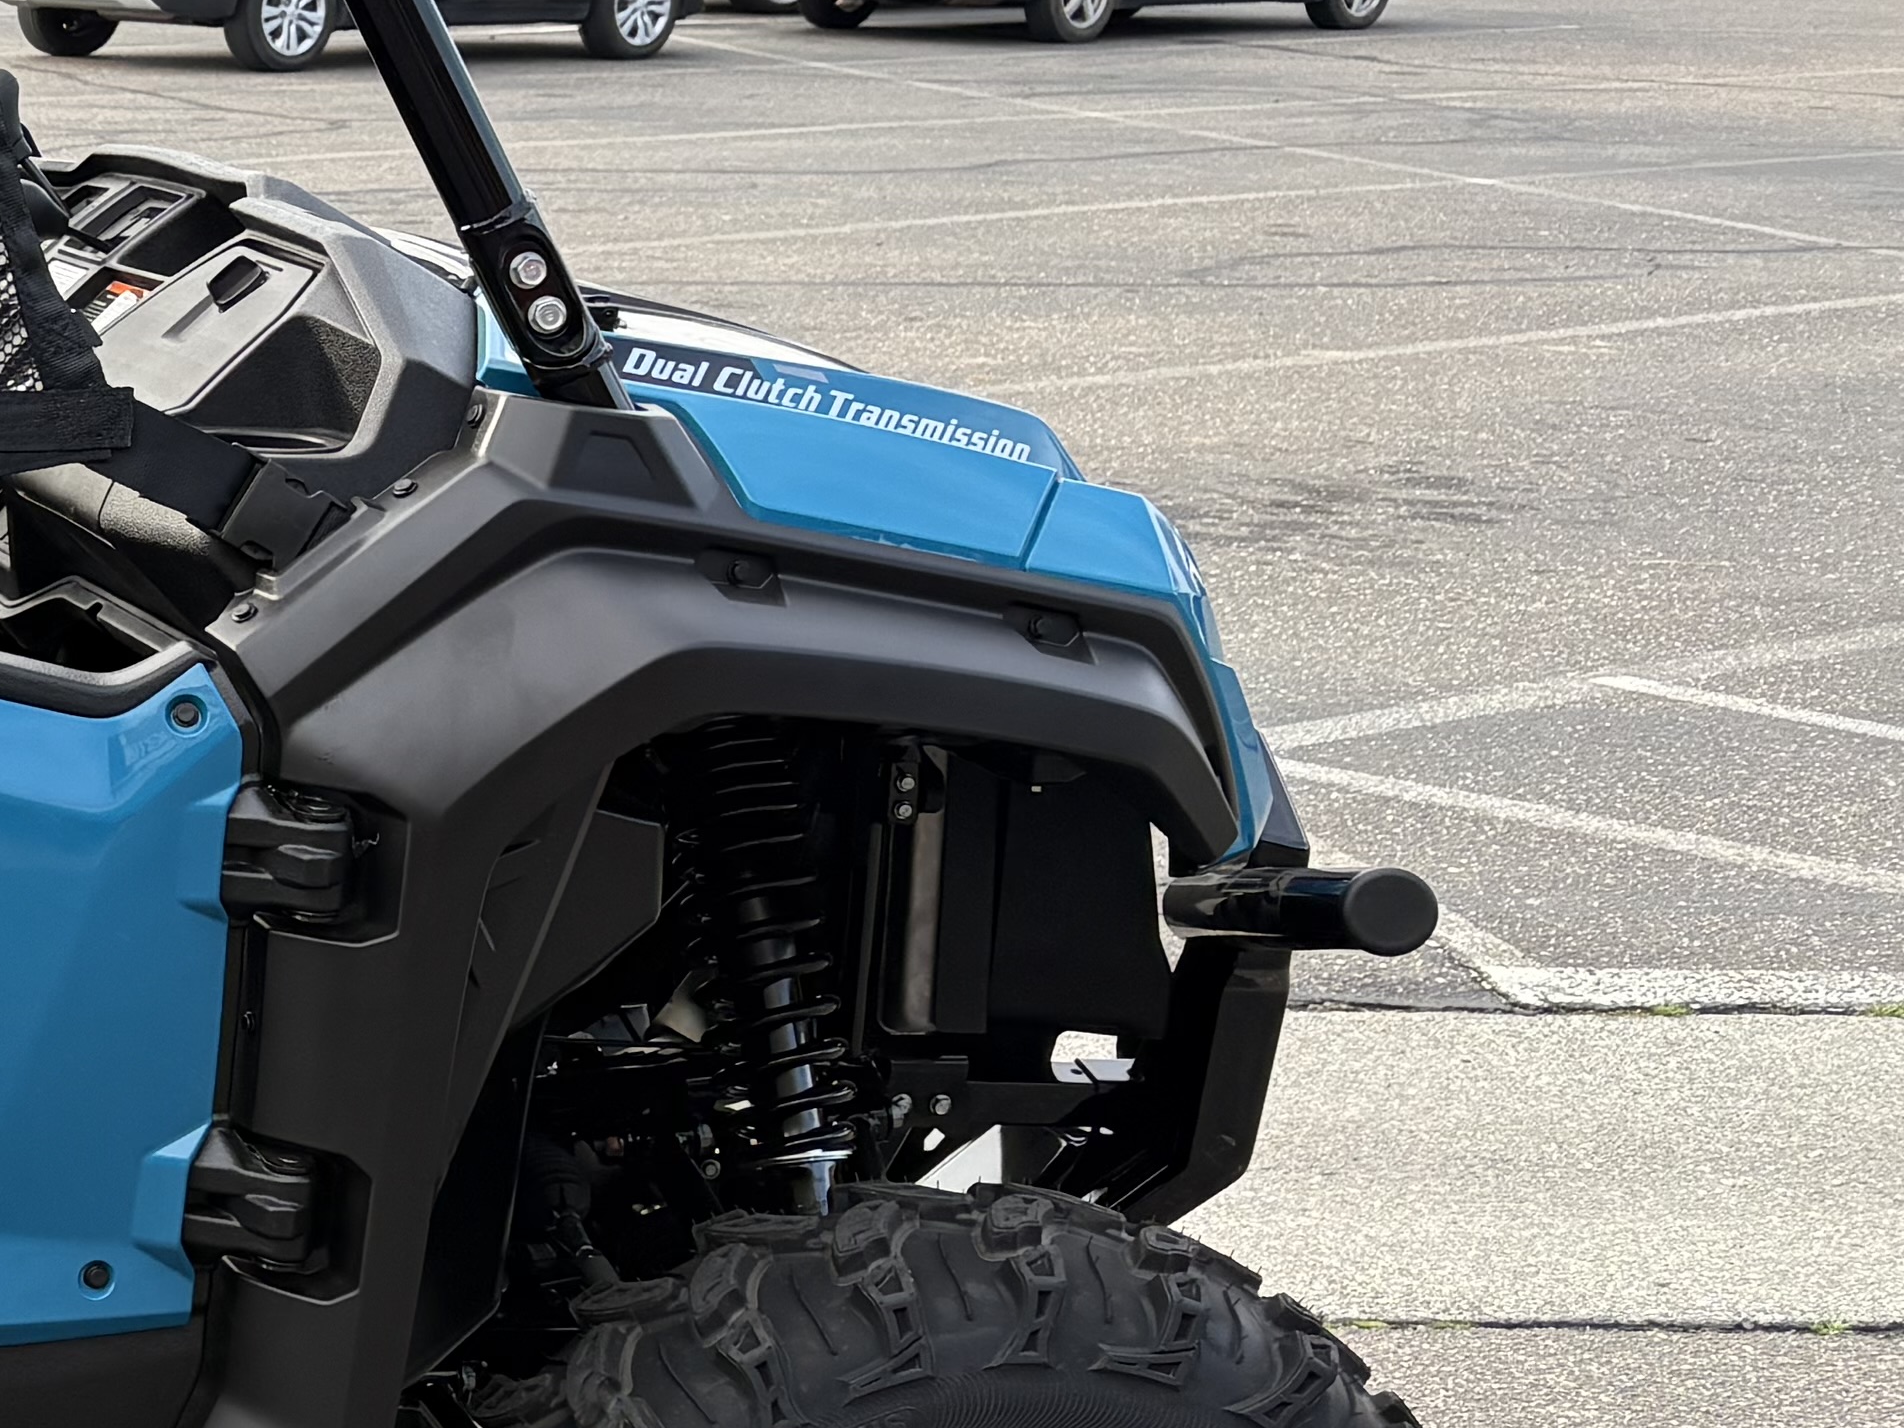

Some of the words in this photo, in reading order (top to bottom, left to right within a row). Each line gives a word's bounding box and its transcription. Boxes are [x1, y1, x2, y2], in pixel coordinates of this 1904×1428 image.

[622, 347, 709, 388] Dual
[712, 366, 822, 413] Clutch
[827, 389, 1031, 462] Transmission
